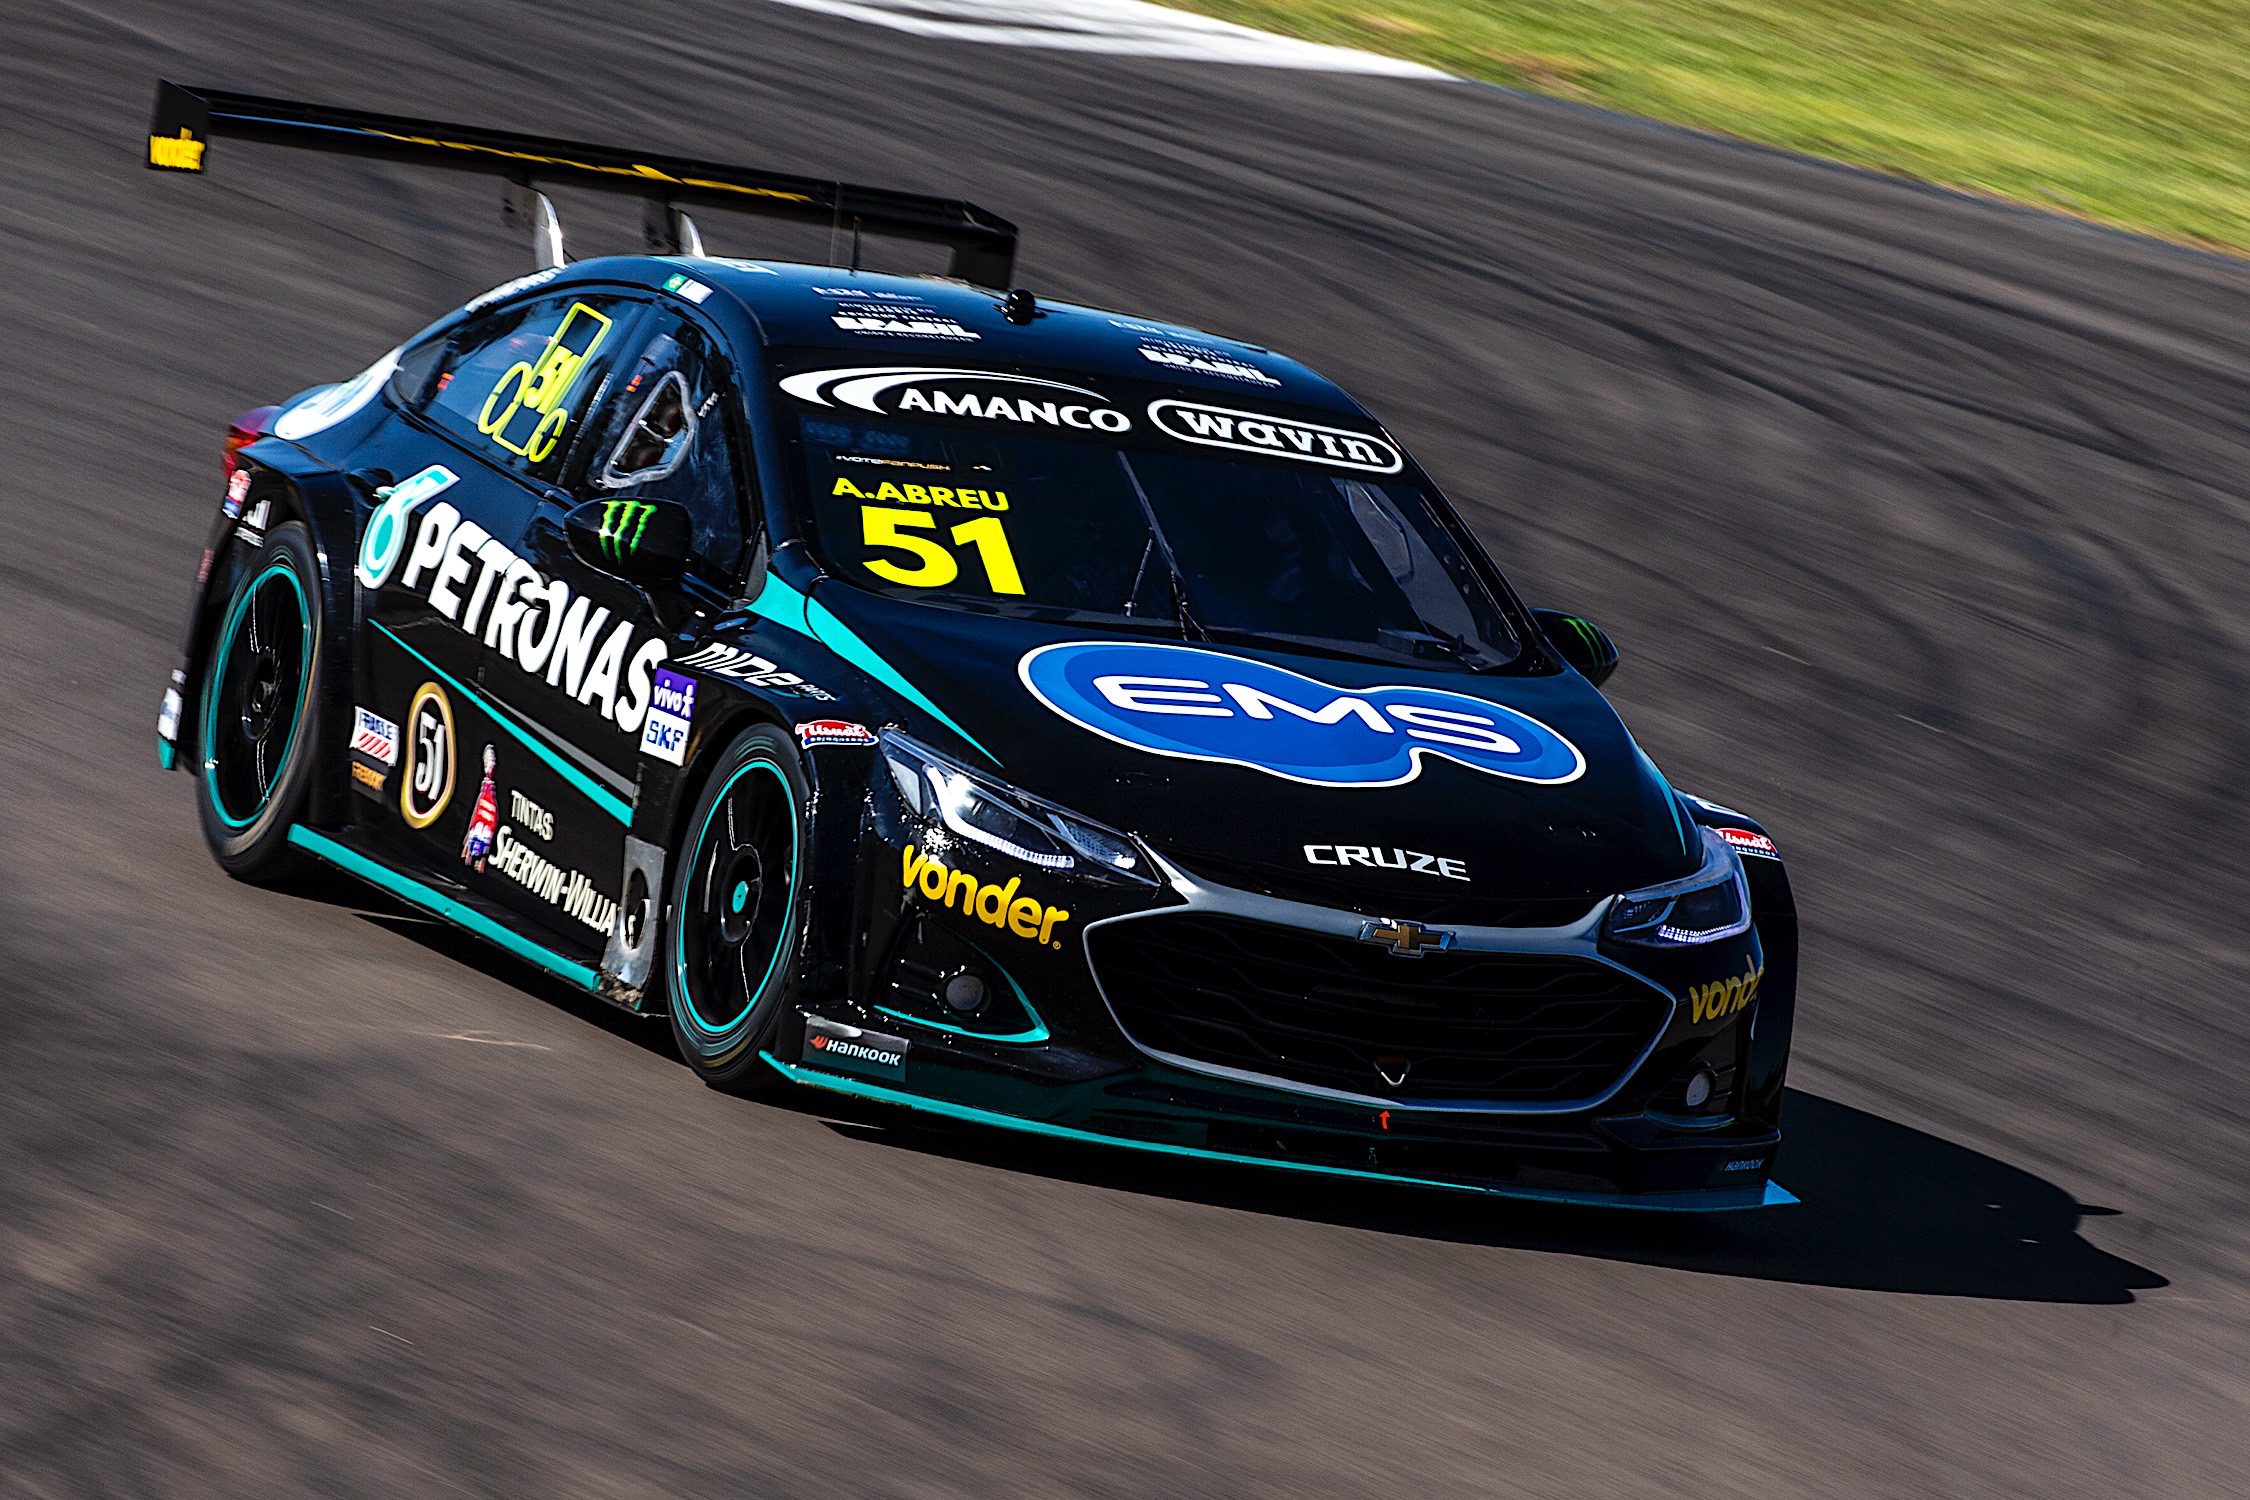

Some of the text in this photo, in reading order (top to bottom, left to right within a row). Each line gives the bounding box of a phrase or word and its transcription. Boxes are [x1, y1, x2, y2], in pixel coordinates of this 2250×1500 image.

[523, 345, 582, 414] 51
[898, 387, 1133, 433] AMANCO
[832, 477, 1009, 511] A.ABREU
[861, 505, 1026, 596] 51
[402, 502, 668, 732] PETRONAS
[654, 678, 682, 713] vivo
[1093, 676, 1520, 754] EMS
[415, 711, 445, 800] 51
[646, 720, 684, 752] SKF
[511, 790, 553, 840] TINTAS
[488, 826, 637, 948] SHERWIN-WILLIA
[903, 845, 1069, 945] vonder
[1303, 844, 1471, 882] CRUZE
